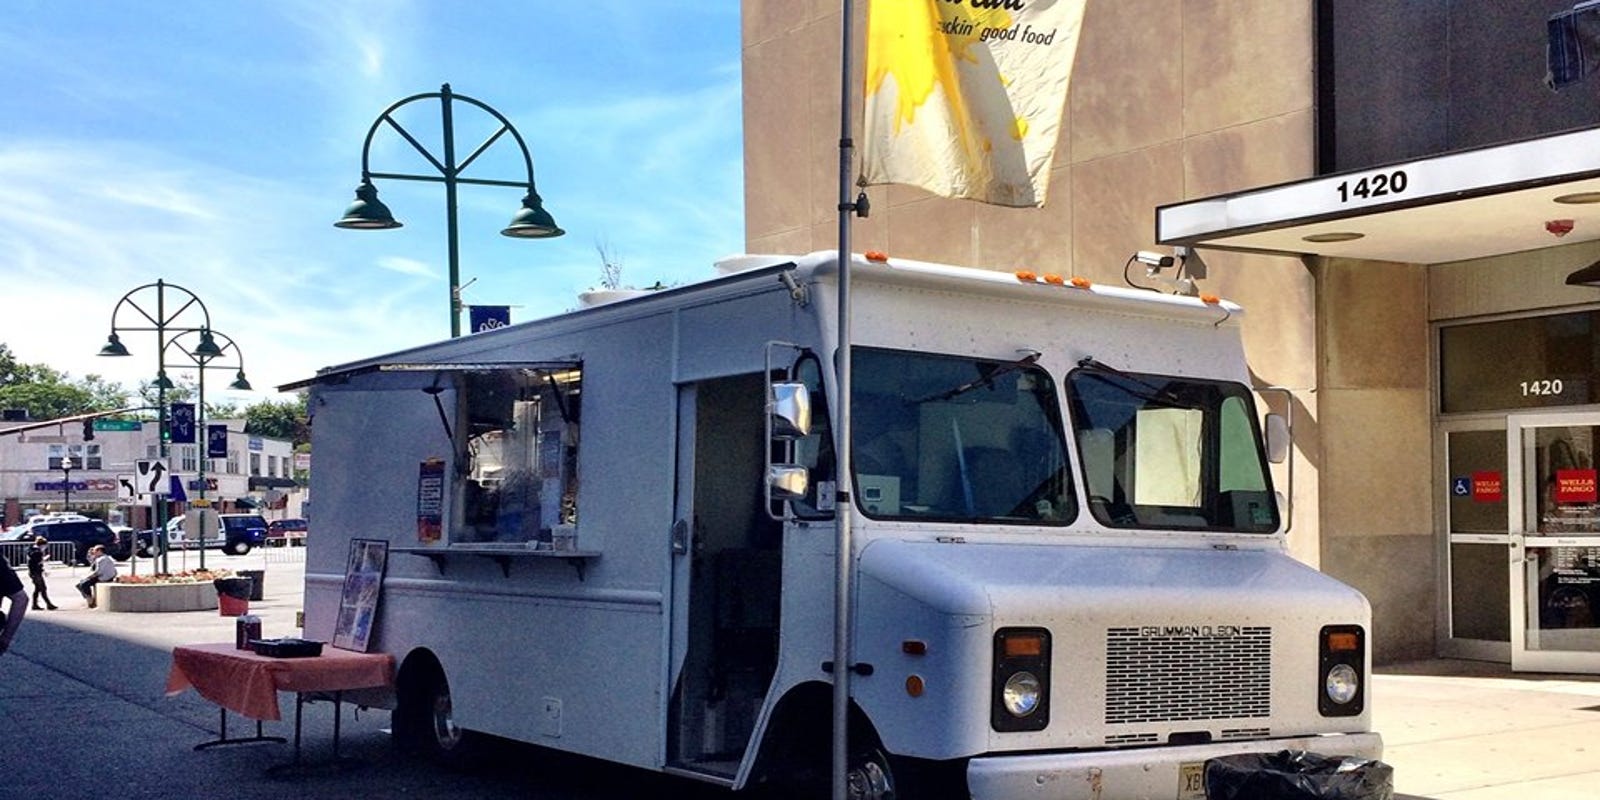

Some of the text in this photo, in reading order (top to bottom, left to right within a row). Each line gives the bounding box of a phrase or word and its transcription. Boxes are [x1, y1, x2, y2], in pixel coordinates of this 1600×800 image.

[980, 23, 1020, 41] good
[1021, 25, 1057, 45] food
[1337, 170, 1407, 202] 1420
[1520, 379, 1563, 396] 1420
[1141, 625, 1240, 637] GRUMMAN OLSON
